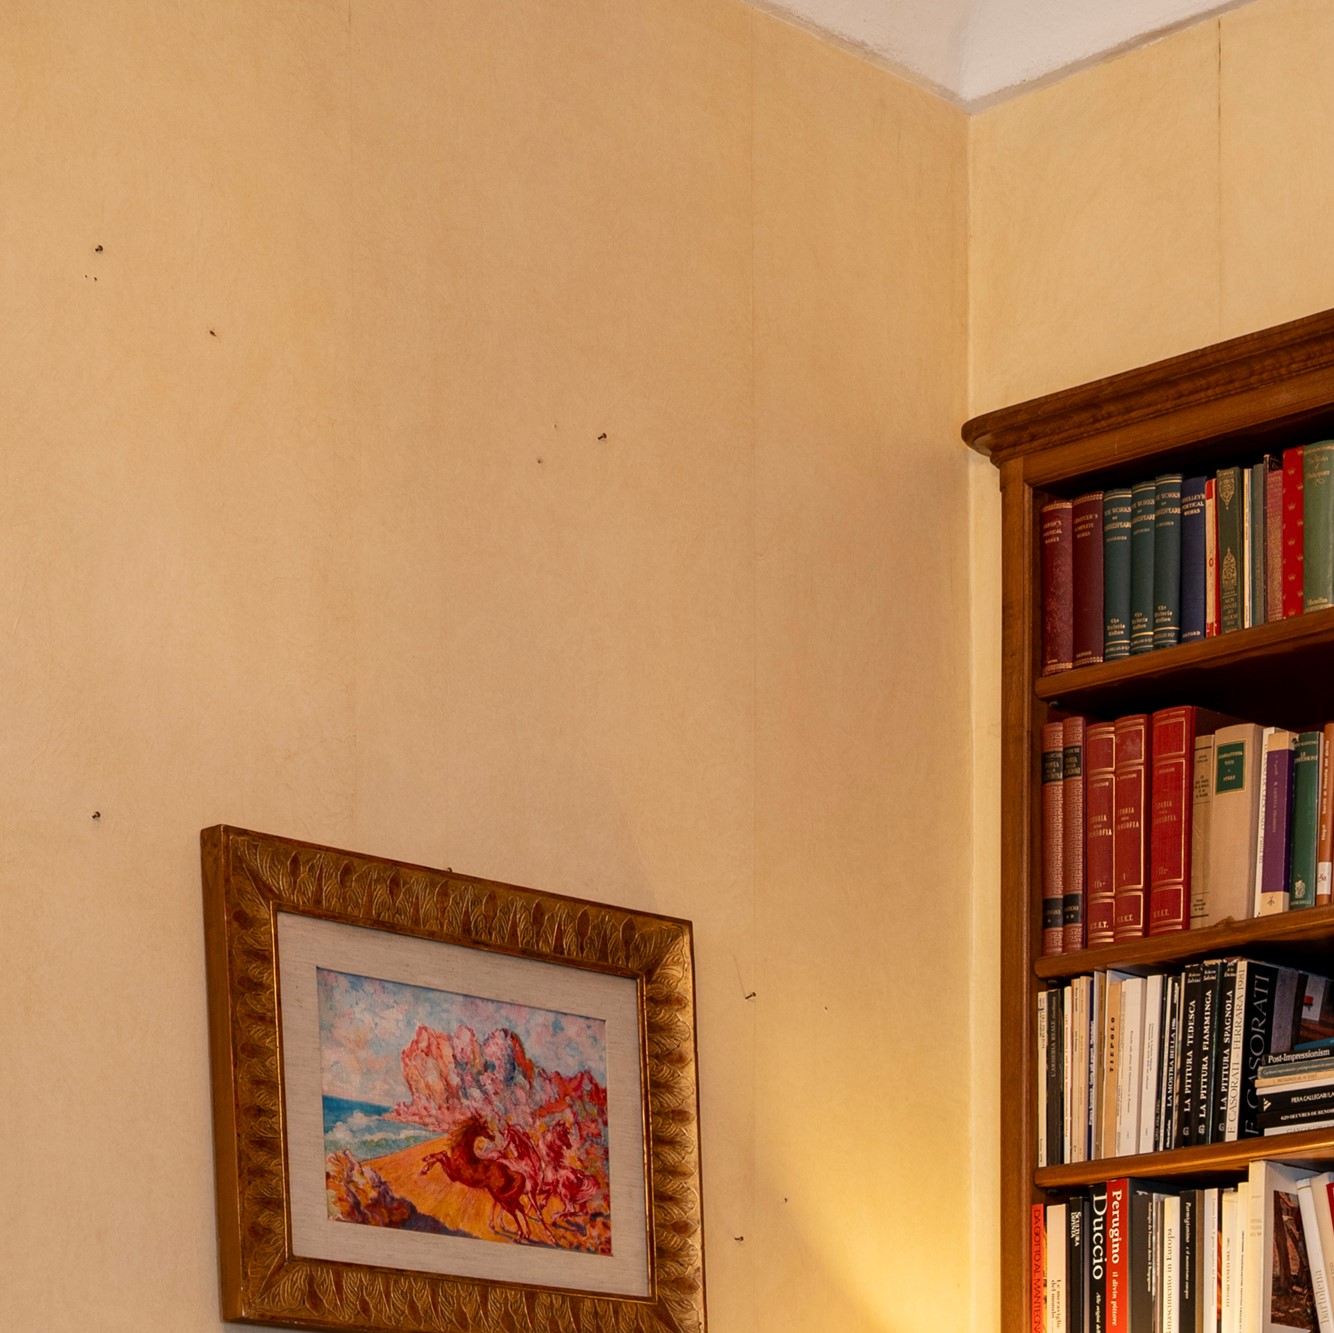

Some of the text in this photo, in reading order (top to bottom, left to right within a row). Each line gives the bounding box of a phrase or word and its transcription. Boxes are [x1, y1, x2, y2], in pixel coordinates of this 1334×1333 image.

[1237, 969, 1245, 990] 1981
[1220, 990, 1234, 1110] LA PITTURA SPAGNOLA
[1233, 994, 1243, 1050] FERRARA
[1183, 1000, 1196, 1112] LA PITTURA TEDESCA
[1199, 990, 1212, 1118] LA PITTURA FIAMMINGA
[1268, 1049, 1330, 1064] Post-Impressionism
[1228, 1062, 1240, 1122] CASORATI
[1092, 1194, 1108, 1280] Duccio
[1108, 1189, 1123, 1264] Perugino
[1166, 1228, 1175, 1260] Europa
[1166, 1263, 1173, 1273] in
[1110, 1300, 1118, 1326] pittore
